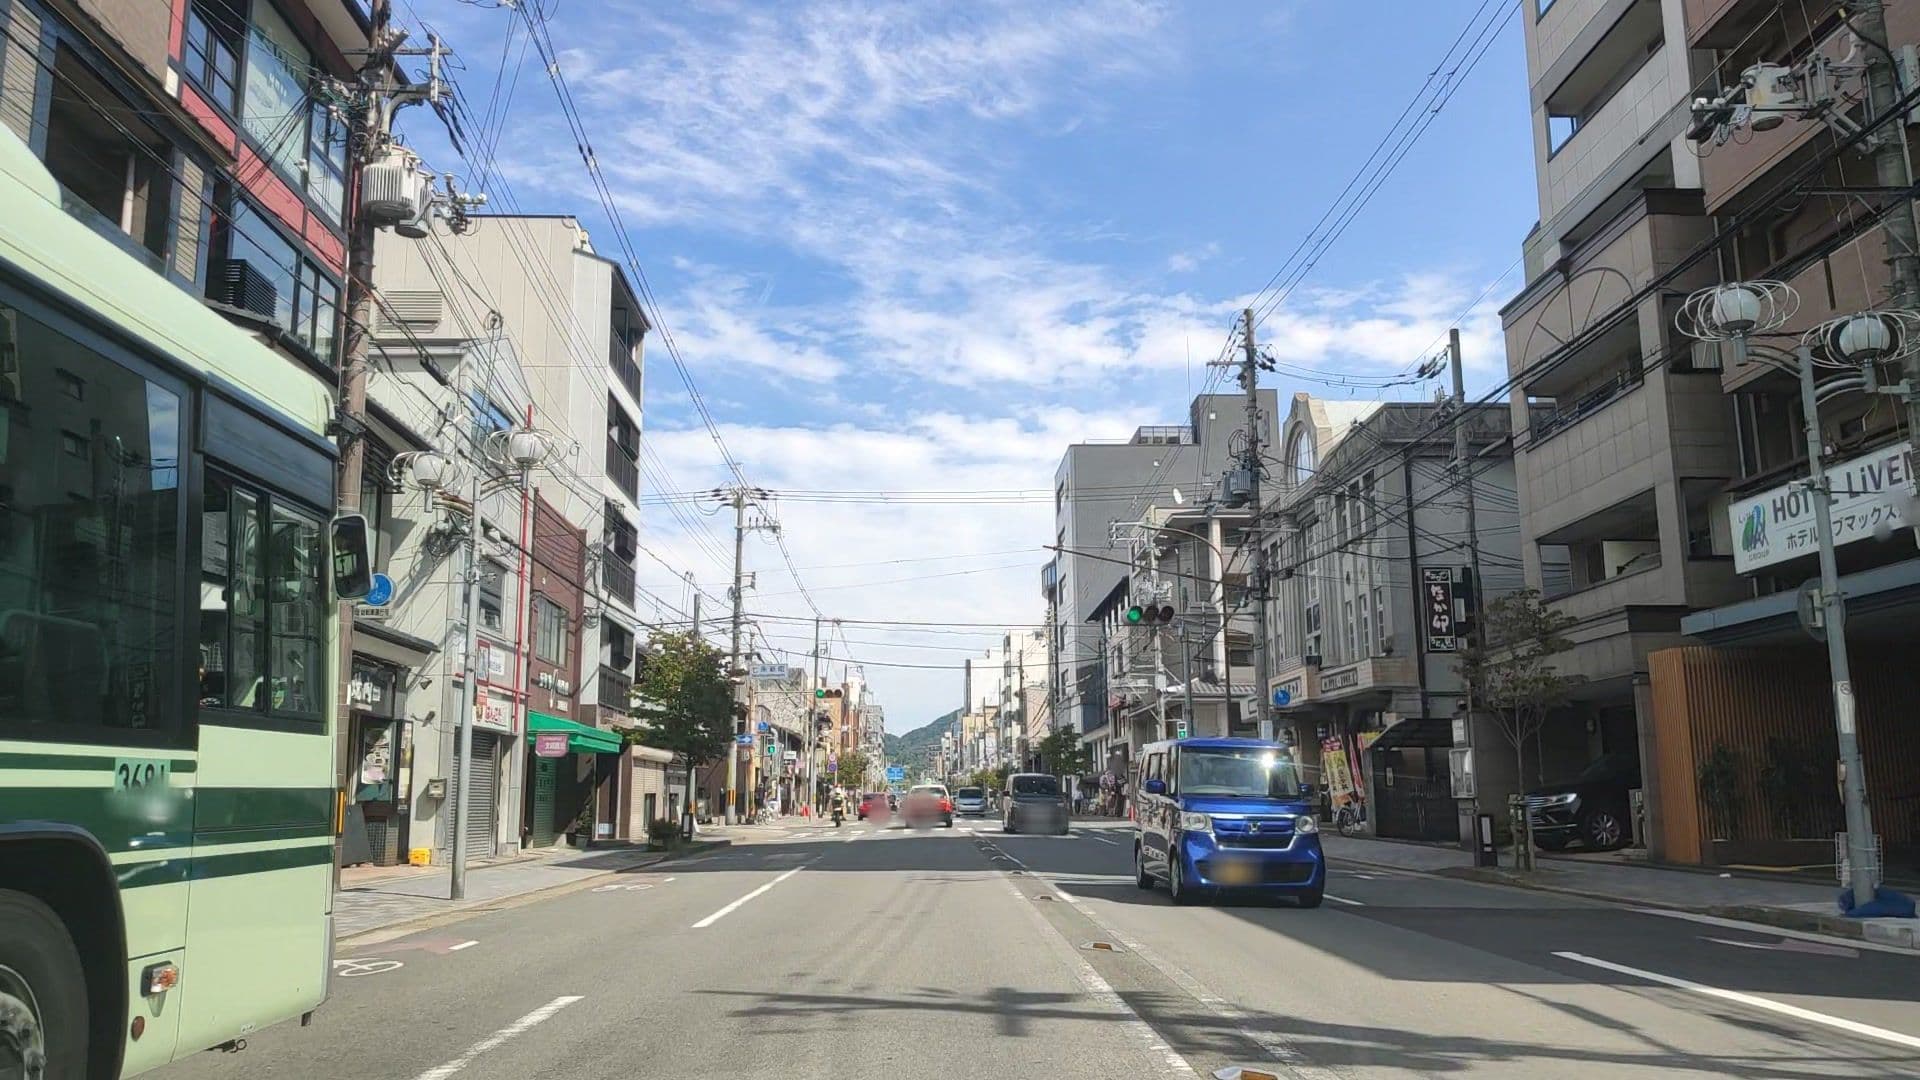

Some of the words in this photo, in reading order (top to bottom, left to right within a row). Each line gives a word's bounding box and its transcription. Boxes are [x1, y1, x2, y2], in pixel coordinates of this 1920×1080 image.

[1772, 484, 1838, 524] HOT
[1786, 504, 1901, 550] ホテルブマックス
